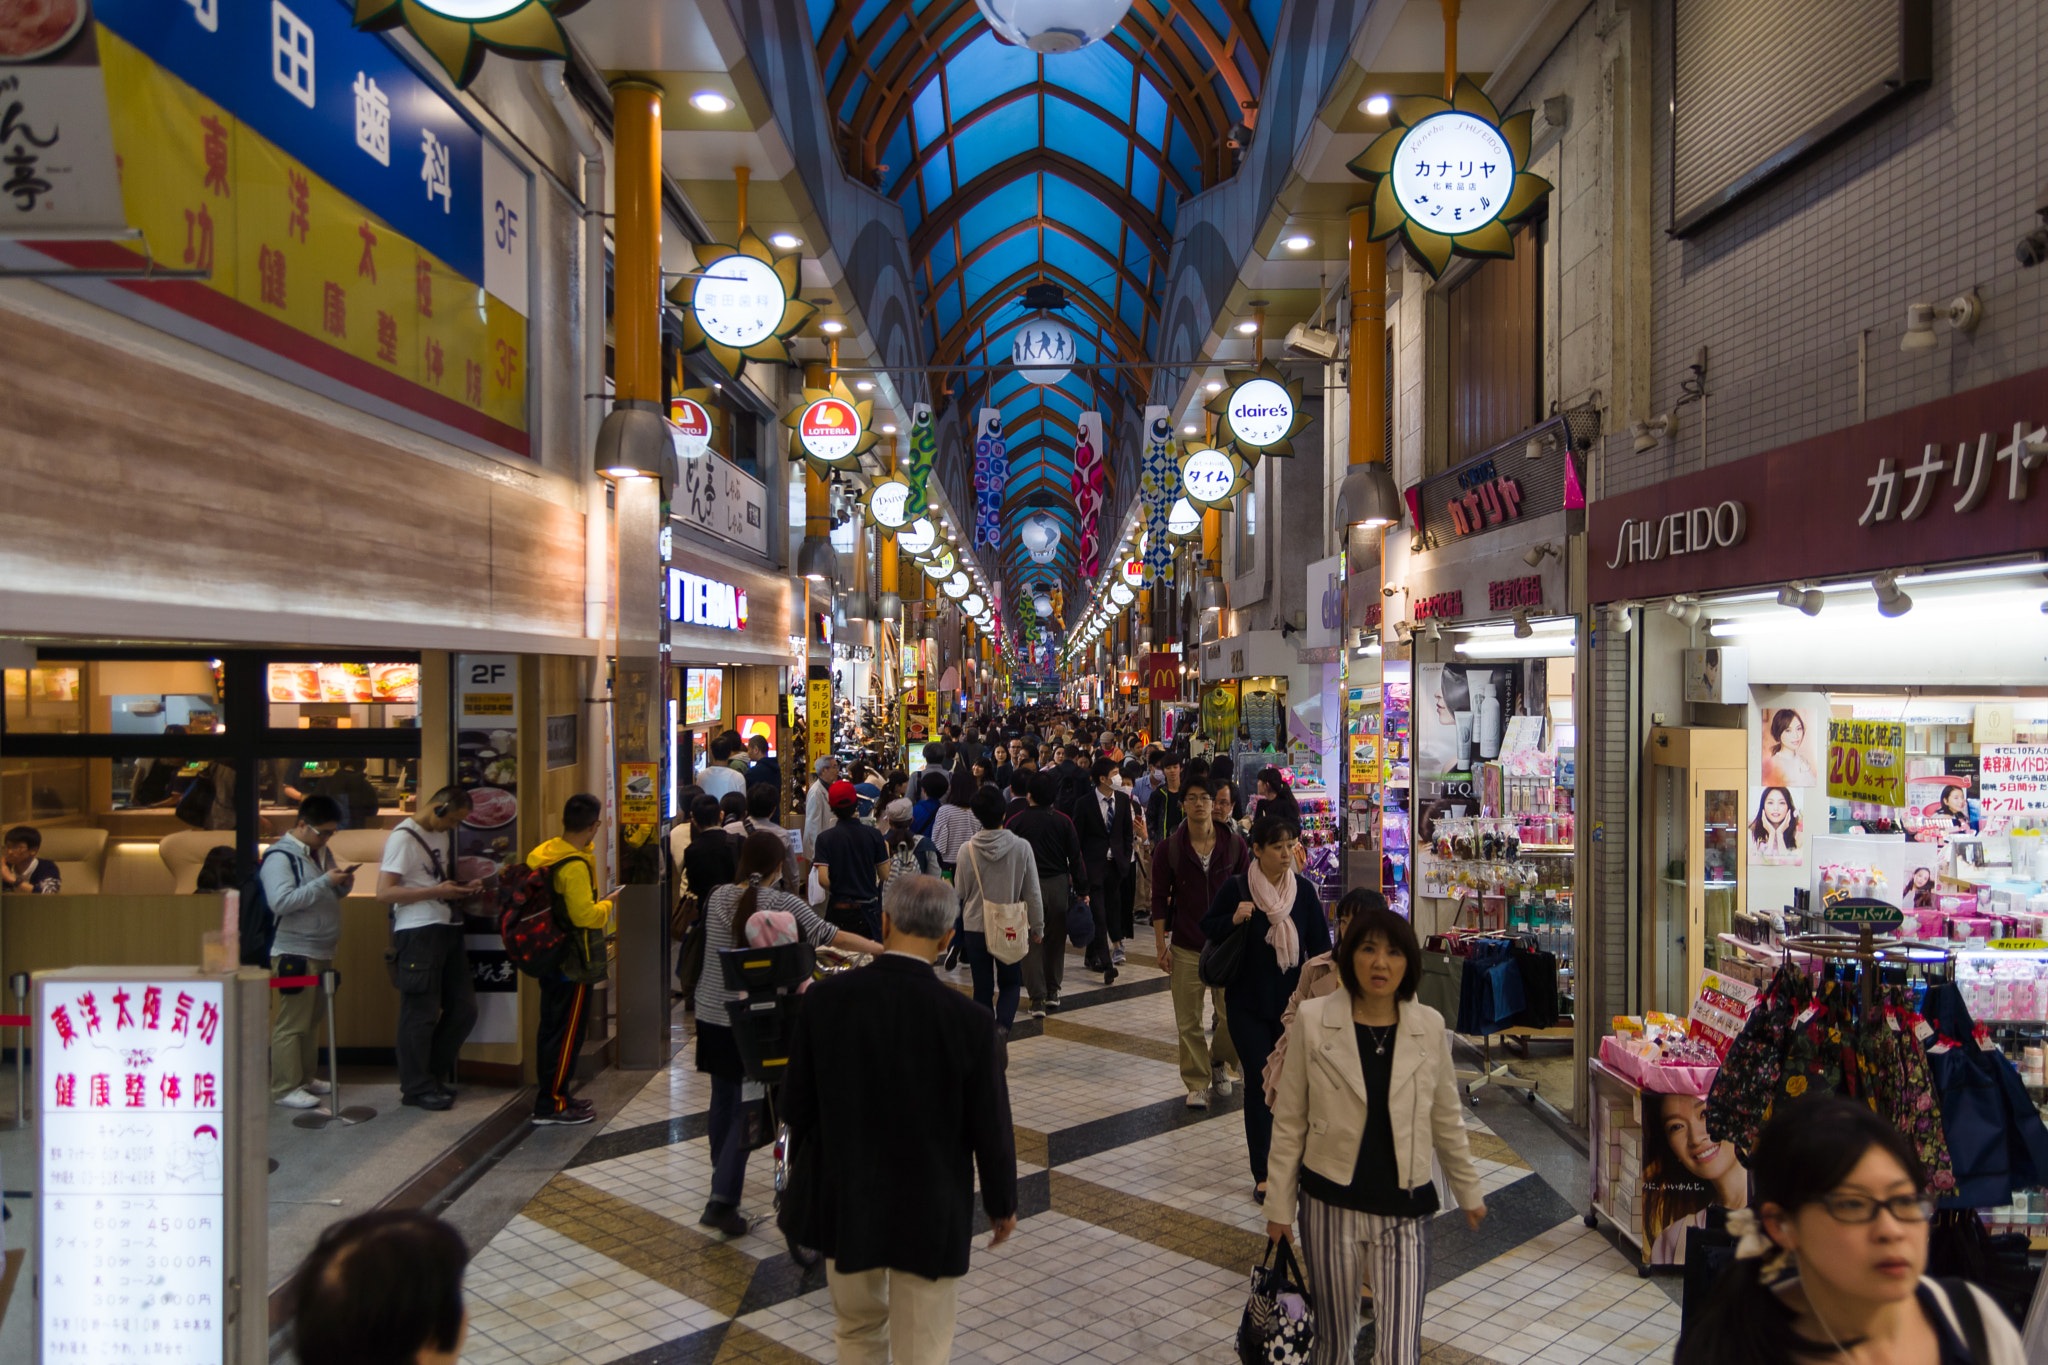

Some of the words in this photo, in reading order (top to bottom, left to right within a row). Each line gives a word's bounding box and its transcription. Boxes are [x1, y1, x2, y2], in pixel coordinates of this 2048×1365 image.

[185, 0, 452, 214] 田歯科
[0, 75, 58, 212] ん亭
[1411, 124, 1445, 154] Kanebo
[1454, 121, 1502, 155] SHISEIDO
[1415, 160, 1496, 178] カナリヤ
[1433, 182, 1477, 191] 化粧品店
[200, 115, 433, 318] 東洋太極
[495, 201, 518, 255] 3F
[114, 152, 482, 407] 功健康整体院
[495, 338, 518, 390] 3F
[1235, 404, 1288, 418] claire's
[808, 427, 850, 435] LOTTERIA
[1189, 471, 1230, 483] タイム
[1858, 421, 2048, 527] カナリヤ
[1447, 476, 1520, 536] カナリヤ
[1606, 501, 1740, 569] SHISEIDO
[471, 664, 506, 684] 2F
[812, 683, 820, 727] 客引き
[821, 683, 829, 727] チラシ配り
[1829, 722, 1903, 747] 資生堂化粧品
[1999, 782, 2037, 792] 5日間分
[1825, 907, 1898, 923] チャームバッグ
[51, 985, 219, 1050] 東洋太極気功
[55, 1072, 217, 1108] 健康整体院
[147, 1255, 211, 1268] 3000円
